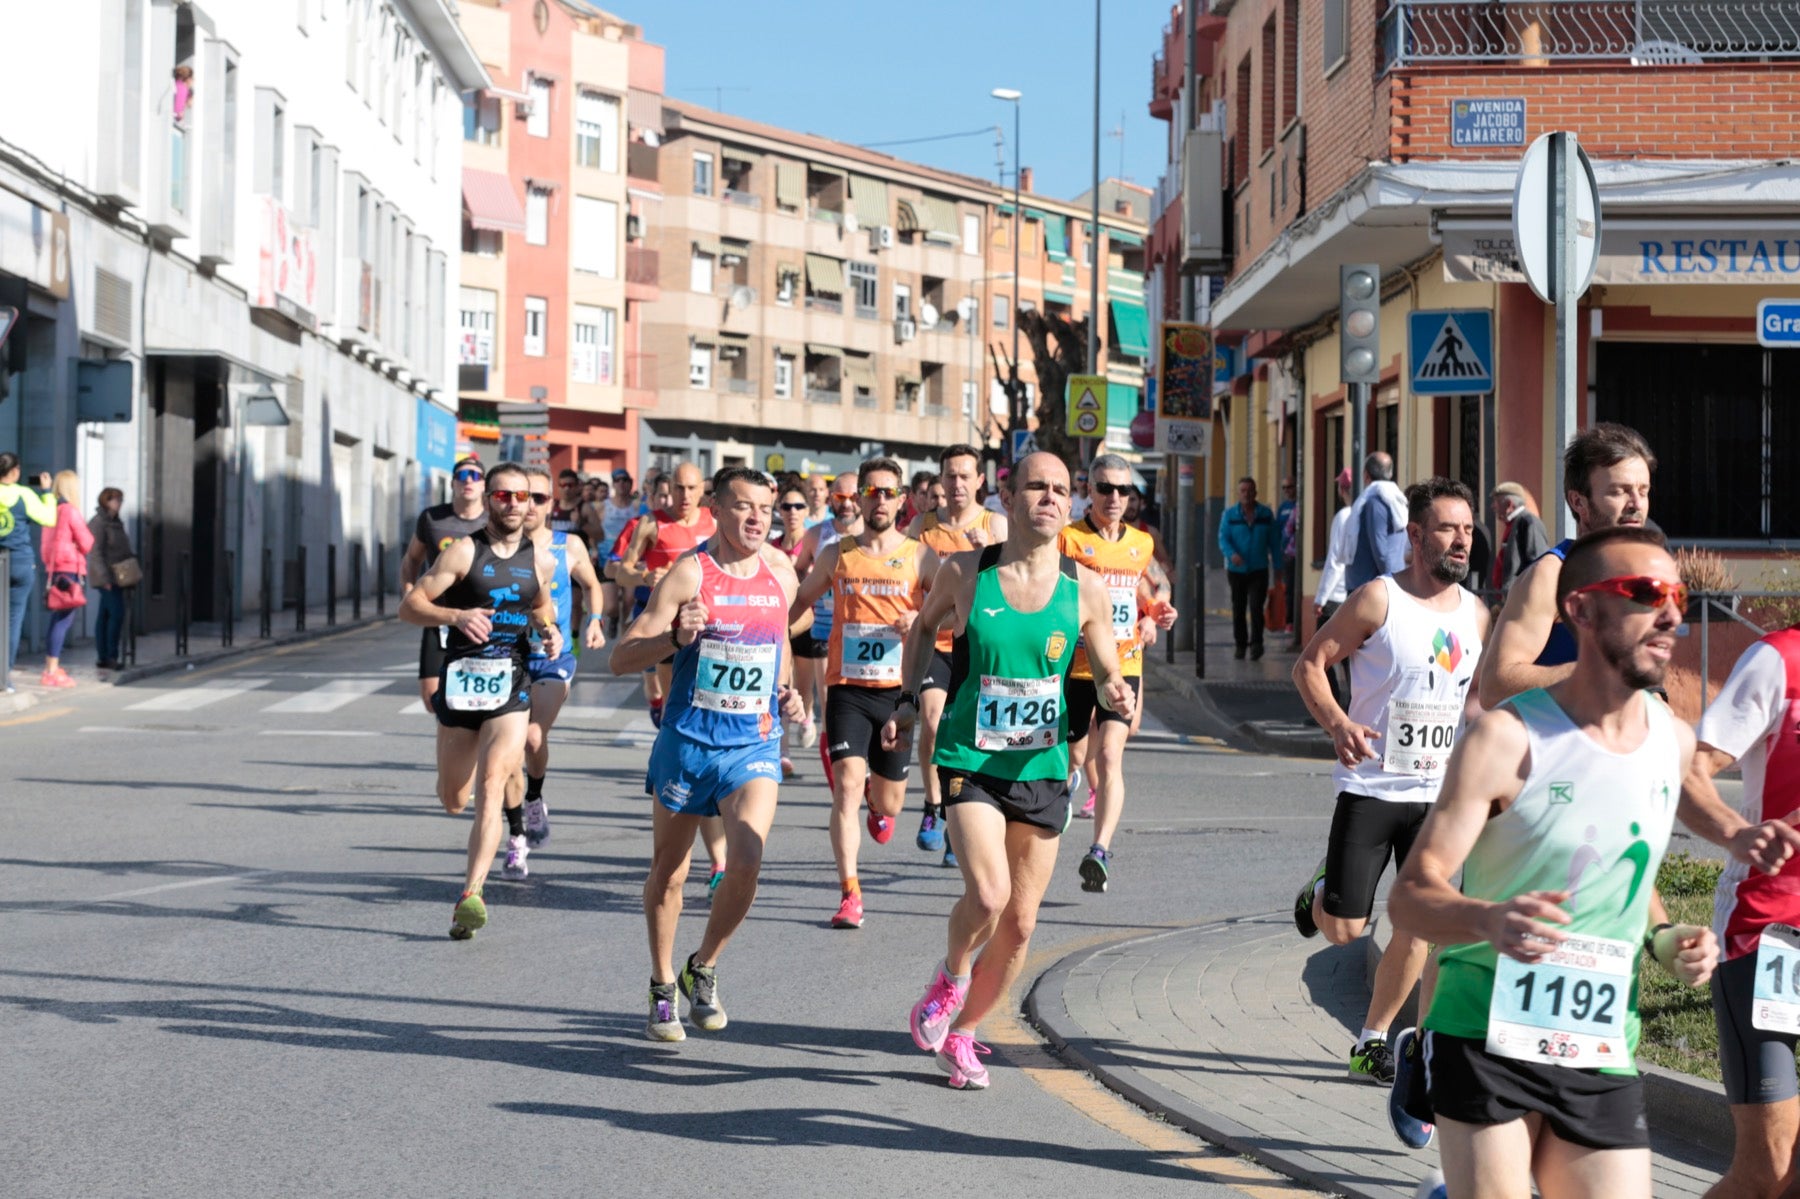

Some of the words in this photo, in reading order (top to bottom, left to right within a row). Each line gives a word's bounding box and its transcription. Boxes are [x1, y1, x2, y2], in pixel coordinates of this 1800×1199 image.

[1470, 101, 1522, 112] AVENIDA
[1473, 113, 1518, 127] JACOBO
[1456, 128, 1522, 142] CAMARERO
[748, 594, 780, 608] SEUR
[857, 641, 885, 662] 20
[460, 674, 500, 694] 186
[712, 664, 762, 691] 702
[985, 698, 1056, 727] 1126
[1398, 722, 1454, 749] 3100
[1515, 970, 1616, 1024] 1192
